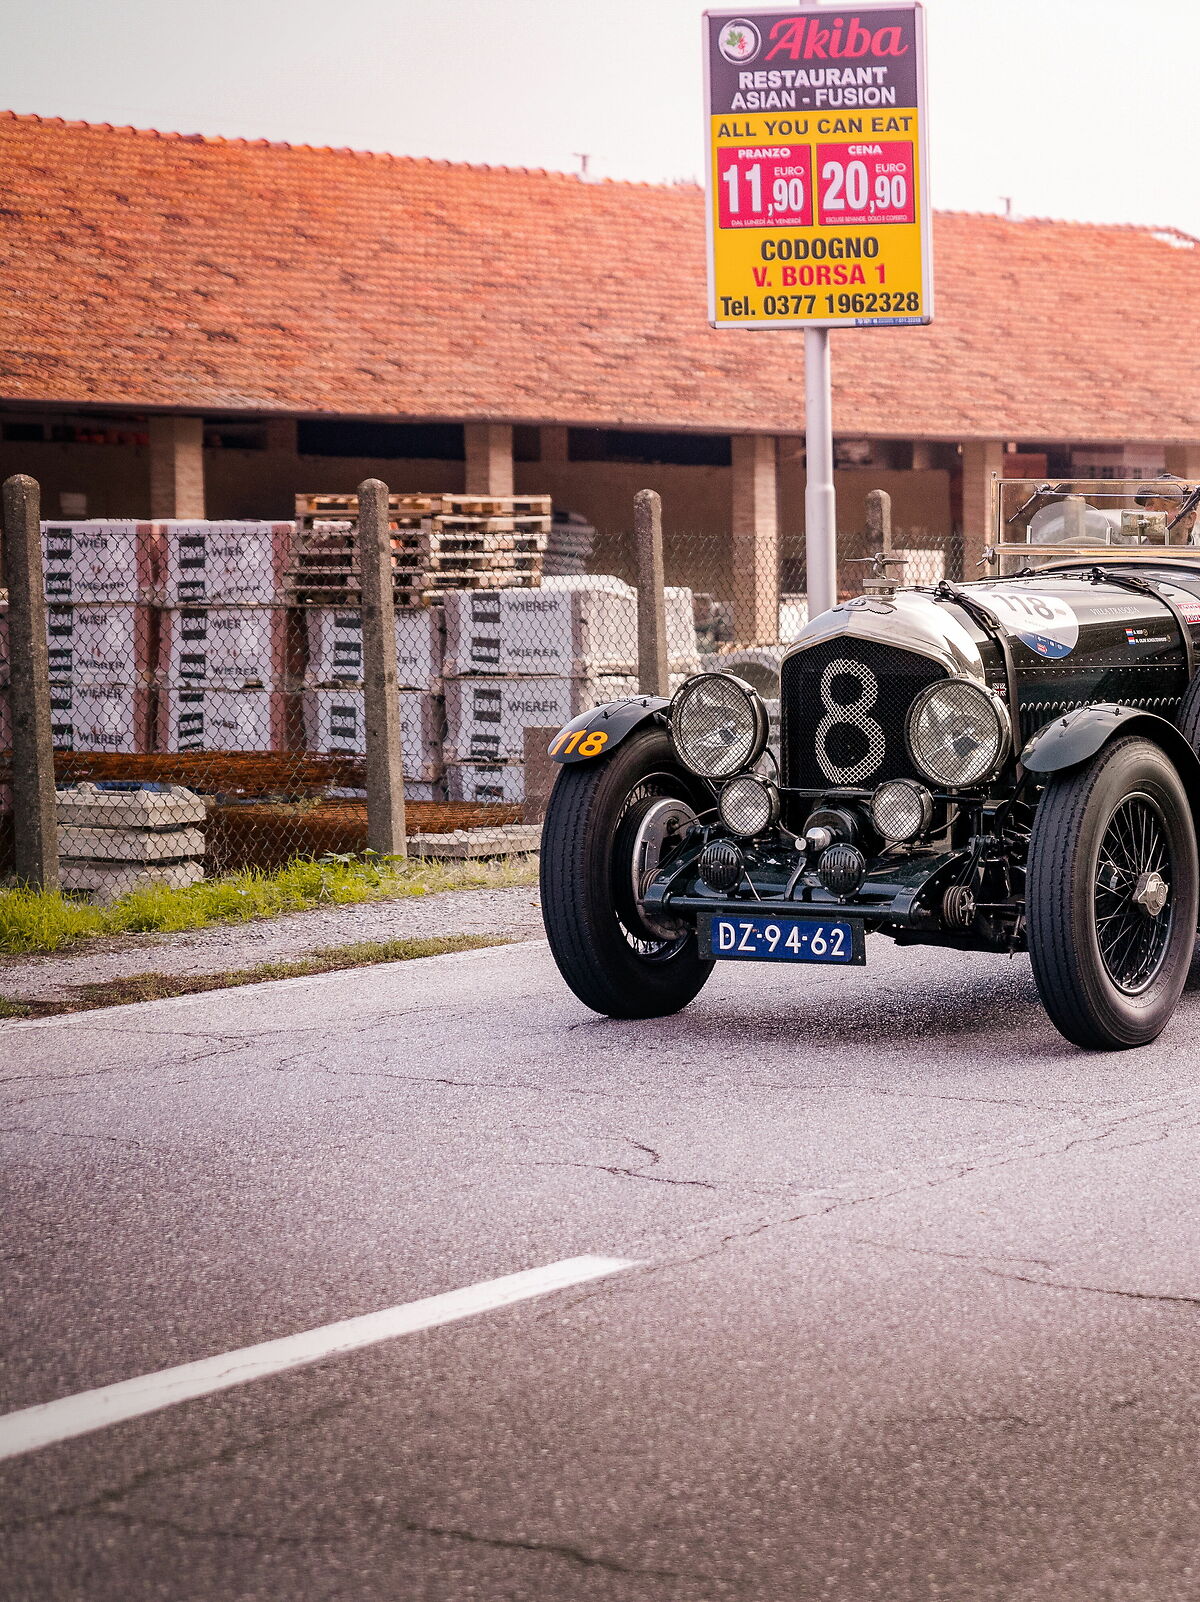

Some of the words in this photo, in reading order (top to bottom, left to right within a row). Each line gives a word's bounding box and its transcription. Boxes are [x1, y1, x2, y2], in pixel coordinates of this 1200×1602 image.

[764, 17, 908, 61] Akiba
[738, 67, 888, 90] RESTAURANT
[730, 90, 797, 110] ASIAN
[815, 86, 896, 107] FUSION
[717, 122, 757, 138] ALL
[764, 119, 809, 136] YOU
[817, 117, 863, 134] CAN
[871, 116, 913, 132] EAT
[738, 147, 791, 159] PRANZO
[848, 145, 882, 155] CENA
[774, 166, 804, 176] EURO
[875, 163, 906, 173] EURO
[761, 236, 879, 261] CODOGNO
[752, 266, 772, 287] V.
[782, 264, 866, 287] BORSA
[875, 263, 886, 284] 1
[720, 296, 756, 316] Tel.
[763, 294, 817, 315] 0377
[825, 292, 920, 314] 1962328
[506, 600, 559, 613] WIERER
[992, 594, 1054, 620] 118
[507, 648, 560, 658] WIERER
[77, 686, 122, 699] WIERER
[508, 700, 559, 712] WIERER
[815, 659, 886, 784] 8
[79, 731, 123, 745] WIERER
[550, 729, 609, 757] 118
[718, 922, 845, 956] DZ-94-62
